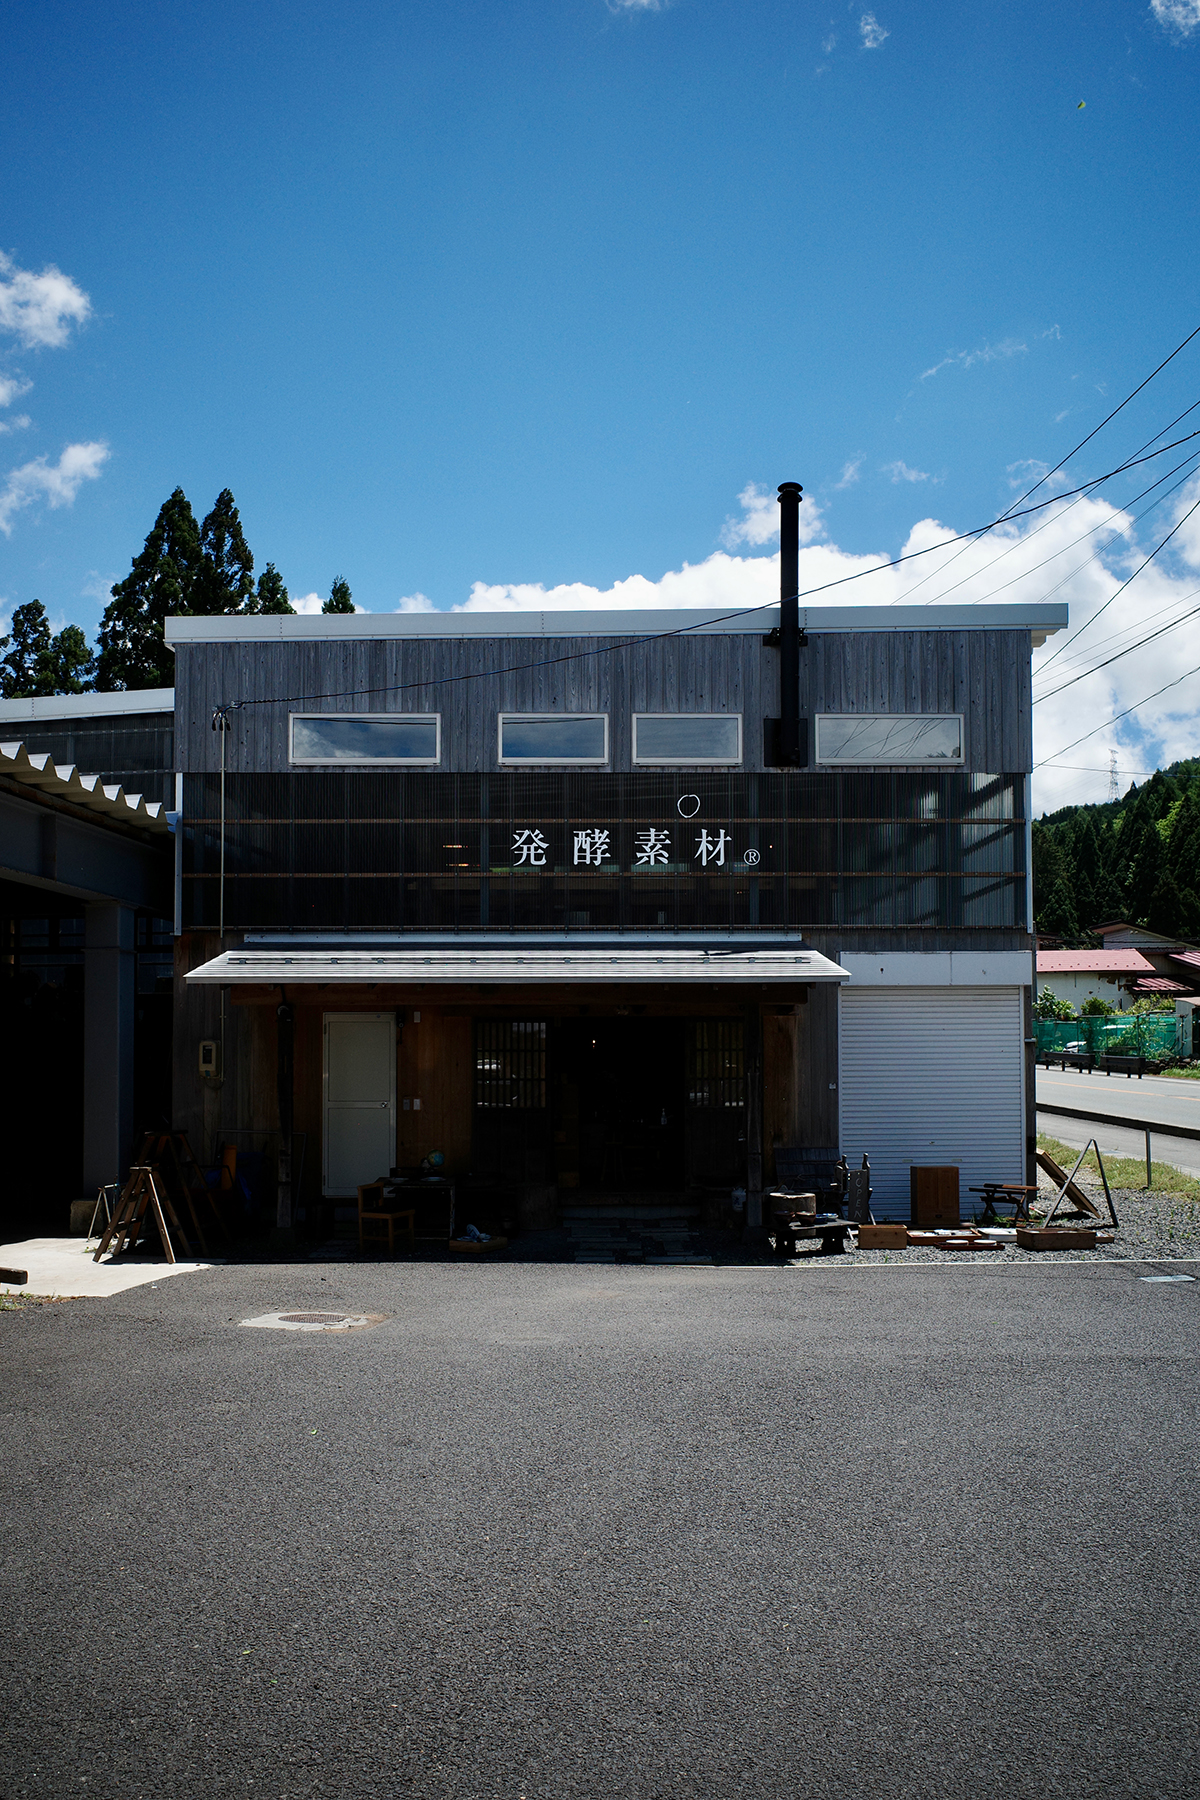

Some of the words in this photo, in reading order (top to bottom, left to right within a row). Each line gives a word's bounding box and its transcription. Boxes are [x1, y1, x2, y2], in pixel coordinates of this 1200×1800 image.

[510, 828, 732, 867] 発酵素材
[854, 1177, 863, 1219] OPEN
